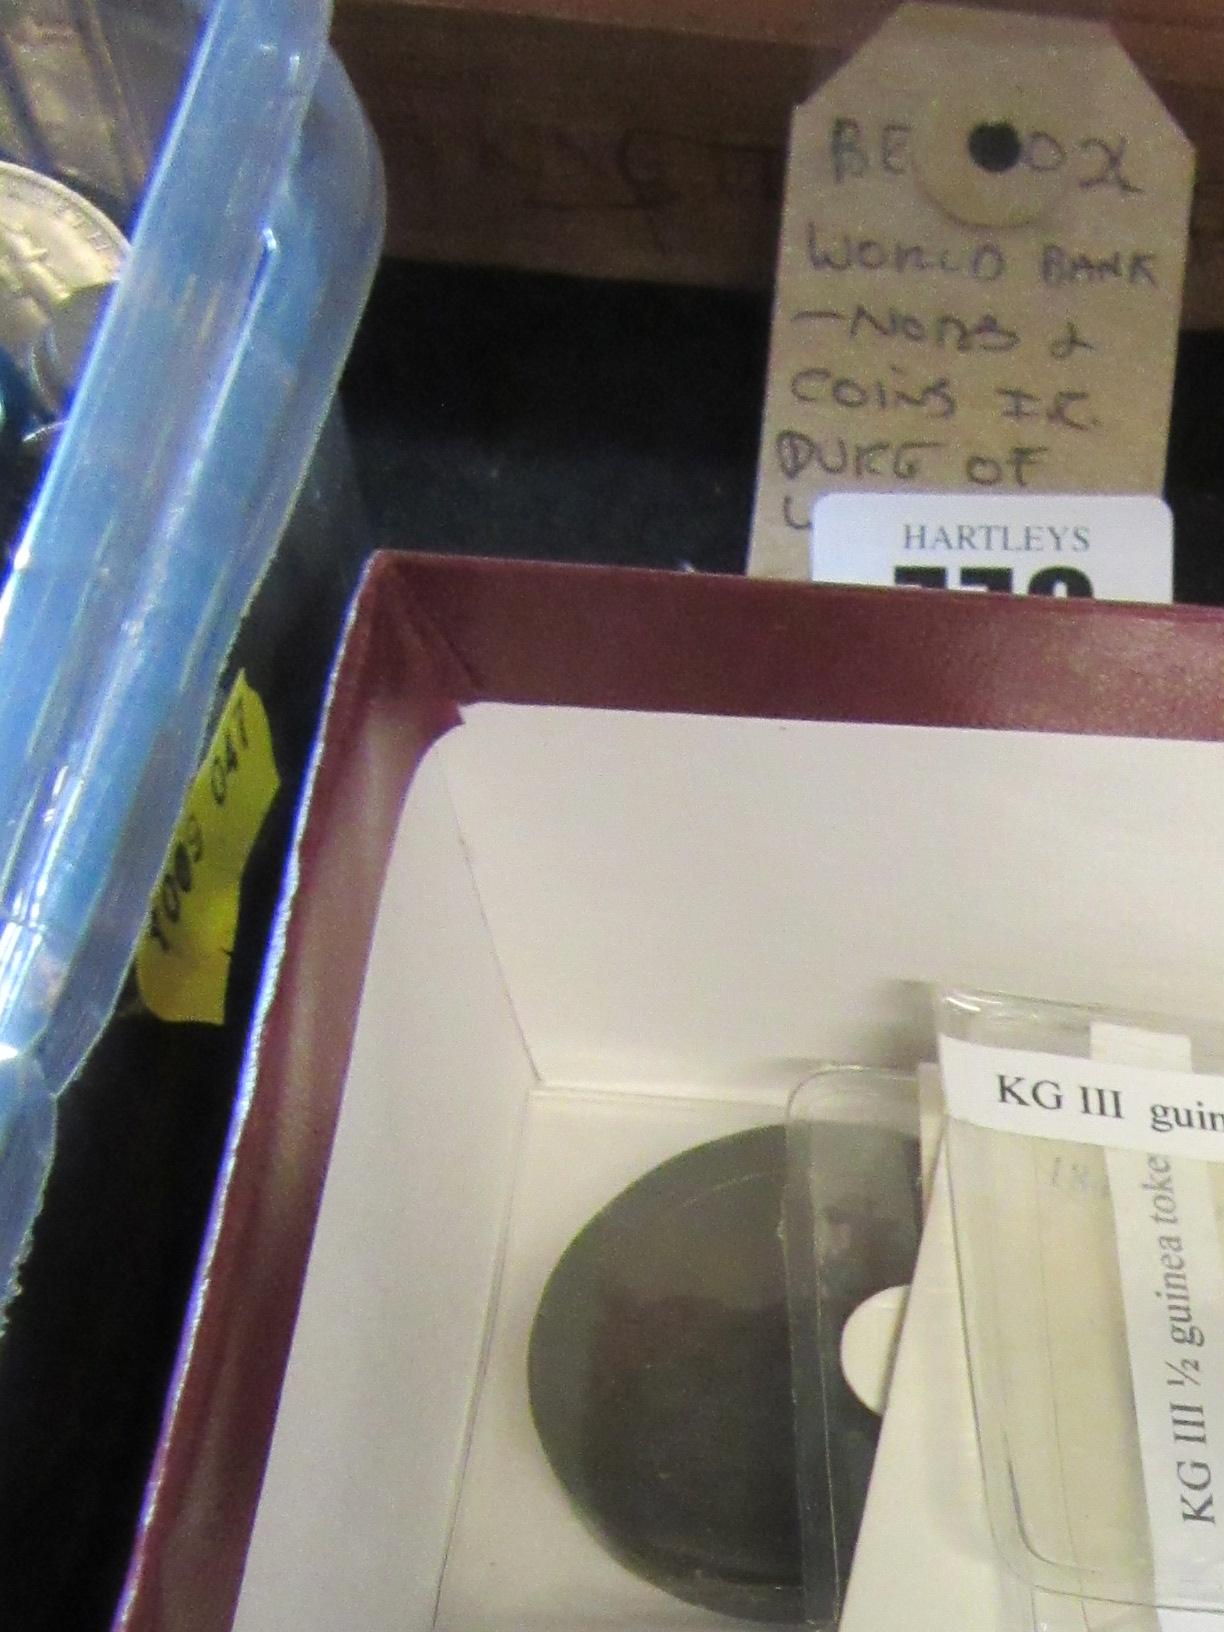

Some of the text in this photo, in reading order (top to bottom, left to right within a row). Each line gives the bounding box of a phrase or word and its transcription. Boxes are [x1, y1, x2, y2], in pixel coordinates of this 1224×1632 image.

[902, 523, 1091, 553] HARTLEYS
[995, 1072, 1065, 1112] KG
[1077, 1085, 1125, 1120] III
[1140, 1149, 1176, 1229] toke
[1153, 1233, 1206, 1350] guinea
[1168, 1400, 1208, 1448] III
[1179, 1458, 1217, 1527] KG
